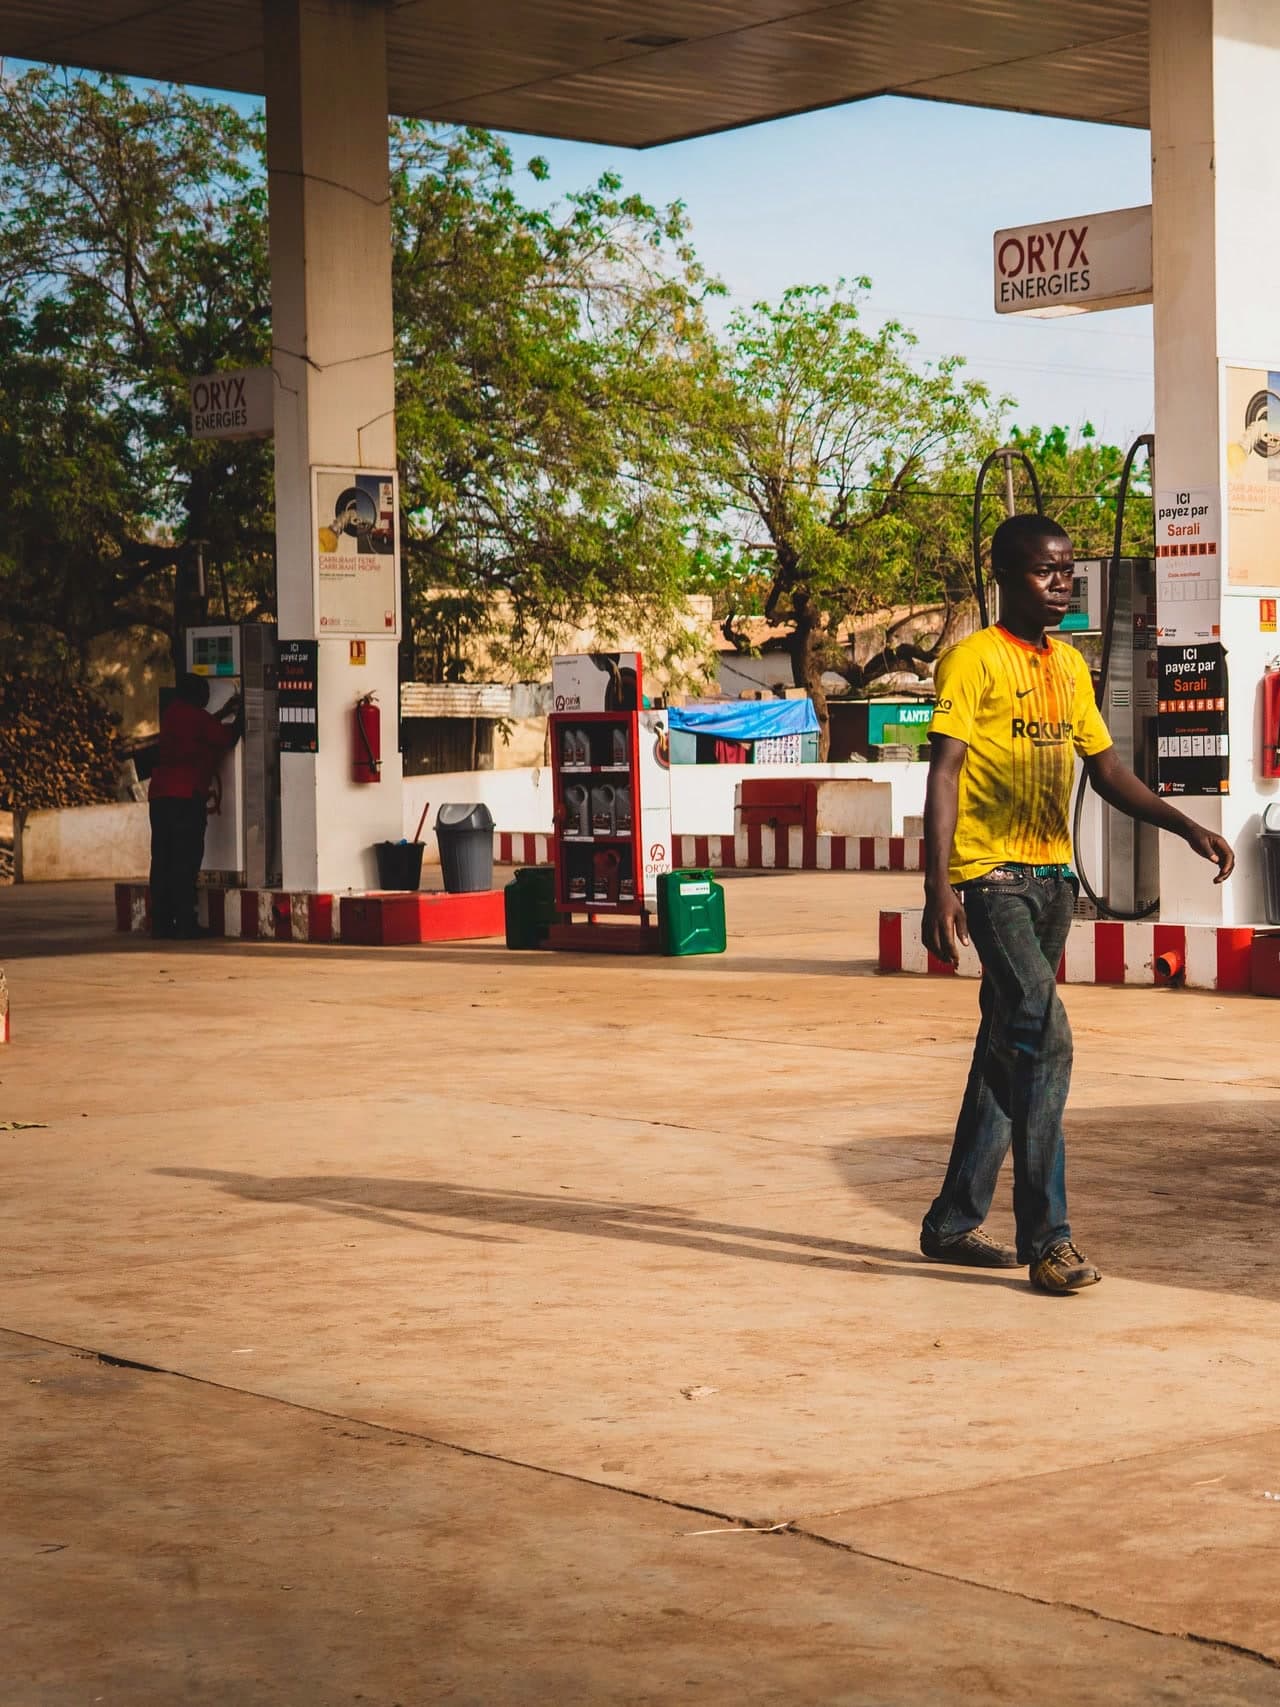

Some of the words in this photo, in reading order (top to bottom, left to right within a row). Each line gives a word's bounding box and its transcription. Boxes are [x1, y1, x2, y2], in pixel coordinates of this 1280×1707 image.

[998, 226, 1090, 278] ORYX
[1001, 270, 1090, 302] ENERGIES
[193, 377, 247, 413] ORYX
[195, 409, 248, 432] ENERGIES
[1176, 492, 1191, 505] ICI
[1159, 507, 1189, 520] payez
[1191, 506, 1208, 518] par
[1167, 522, 1200, 537] Sarali
[291, 644, 299, 652] ICI
[1183, 648, 1197, 660] ICI
[1165, 662, 1196, 675] payez
[1198, 661, 1216, 674] par
[1174, 678, 1207, 692] Sarali
[900, 710, 930, 722] KANTE
[645, 864, 671, 874] ORYX
